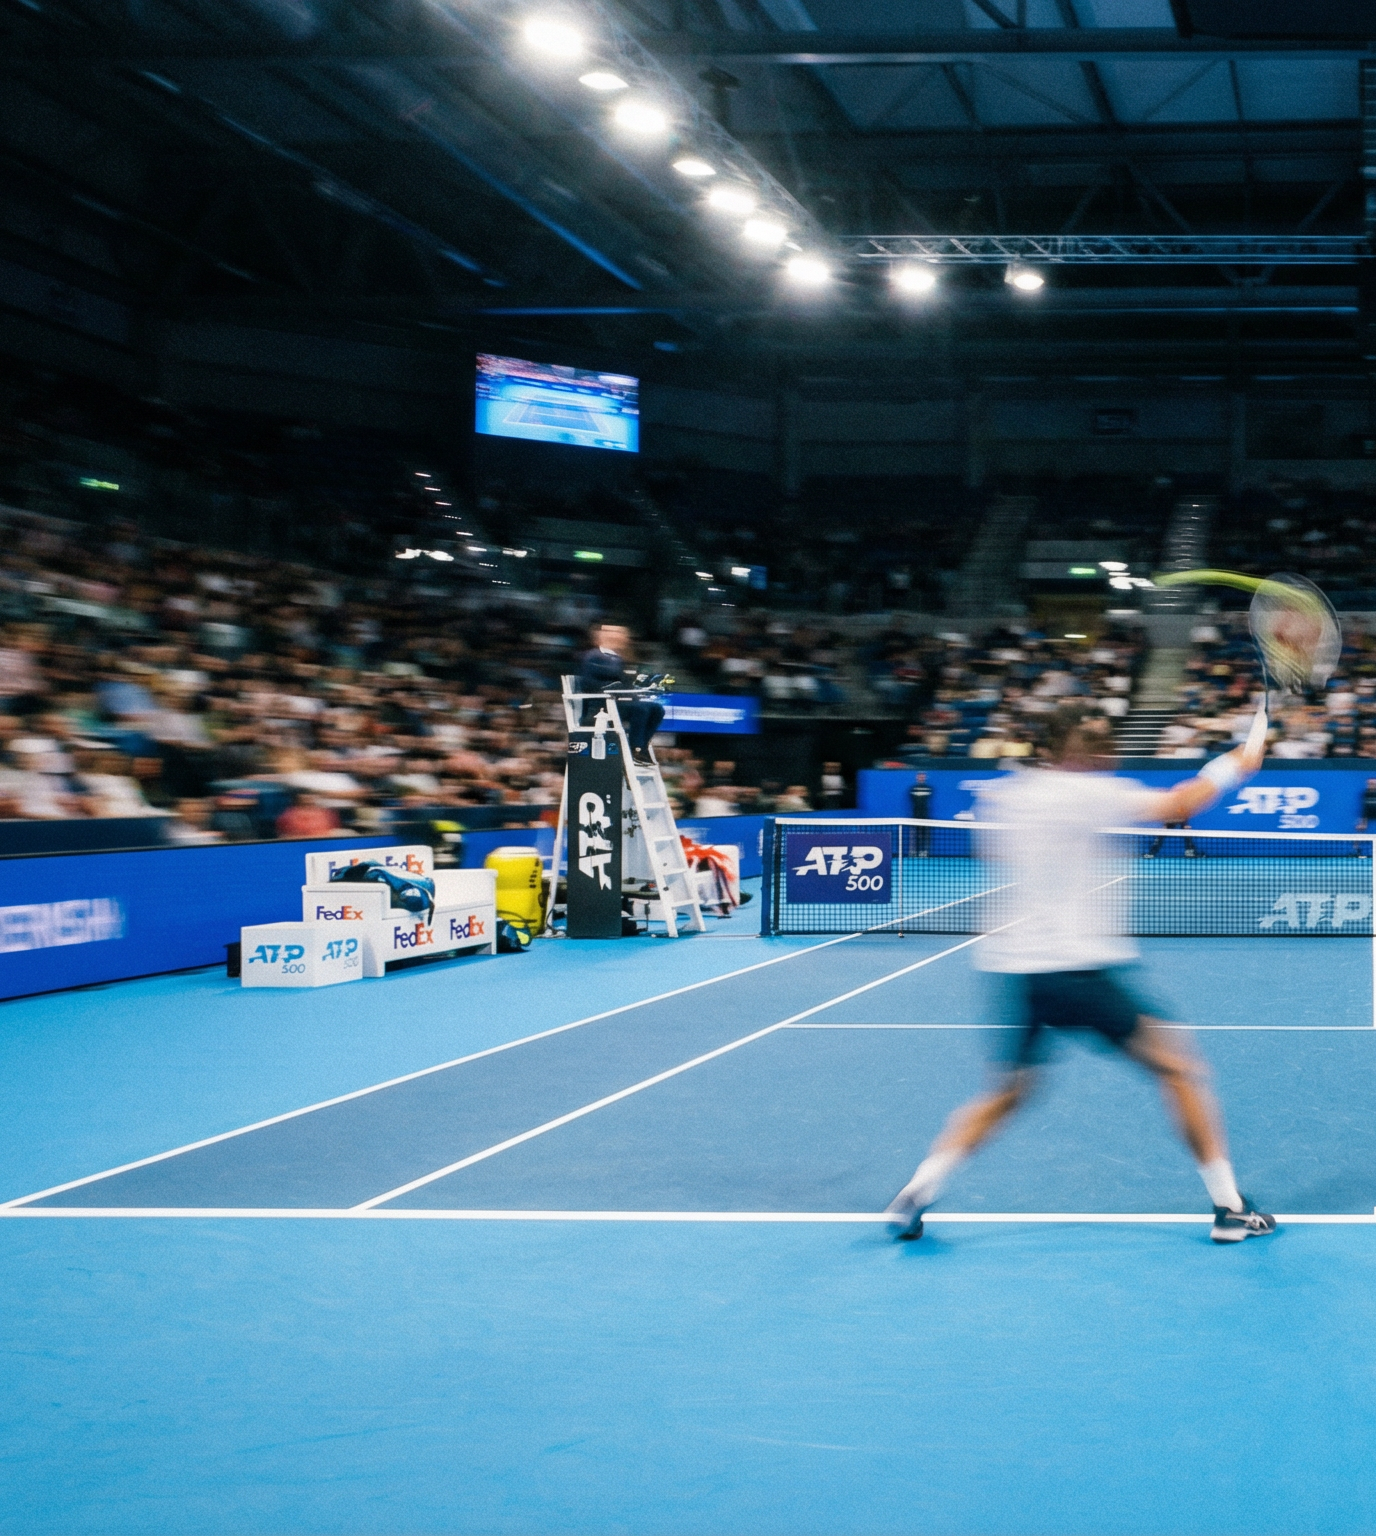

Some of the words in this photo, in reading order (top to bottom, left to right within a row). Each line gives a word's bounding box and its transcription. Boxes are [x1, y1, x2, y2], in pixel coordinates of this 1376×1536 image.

[1225, 787, 1320, 814] ATP
[579, 792, 613, 891] ATP
[792, 846, 883, 876] ATP
[845, 875, 884, 891] 500
[316, 905, 363, 921] FedEx
[1257, 893, 1373, 929] ATP
[394, 922, 434, 950] FedEx
[449, 915, 485, 940] FedEx
[248, 945, 305, 964] ATP
[322, 938, 358, 962] ATP
[282, 963, 306, 974] 500
